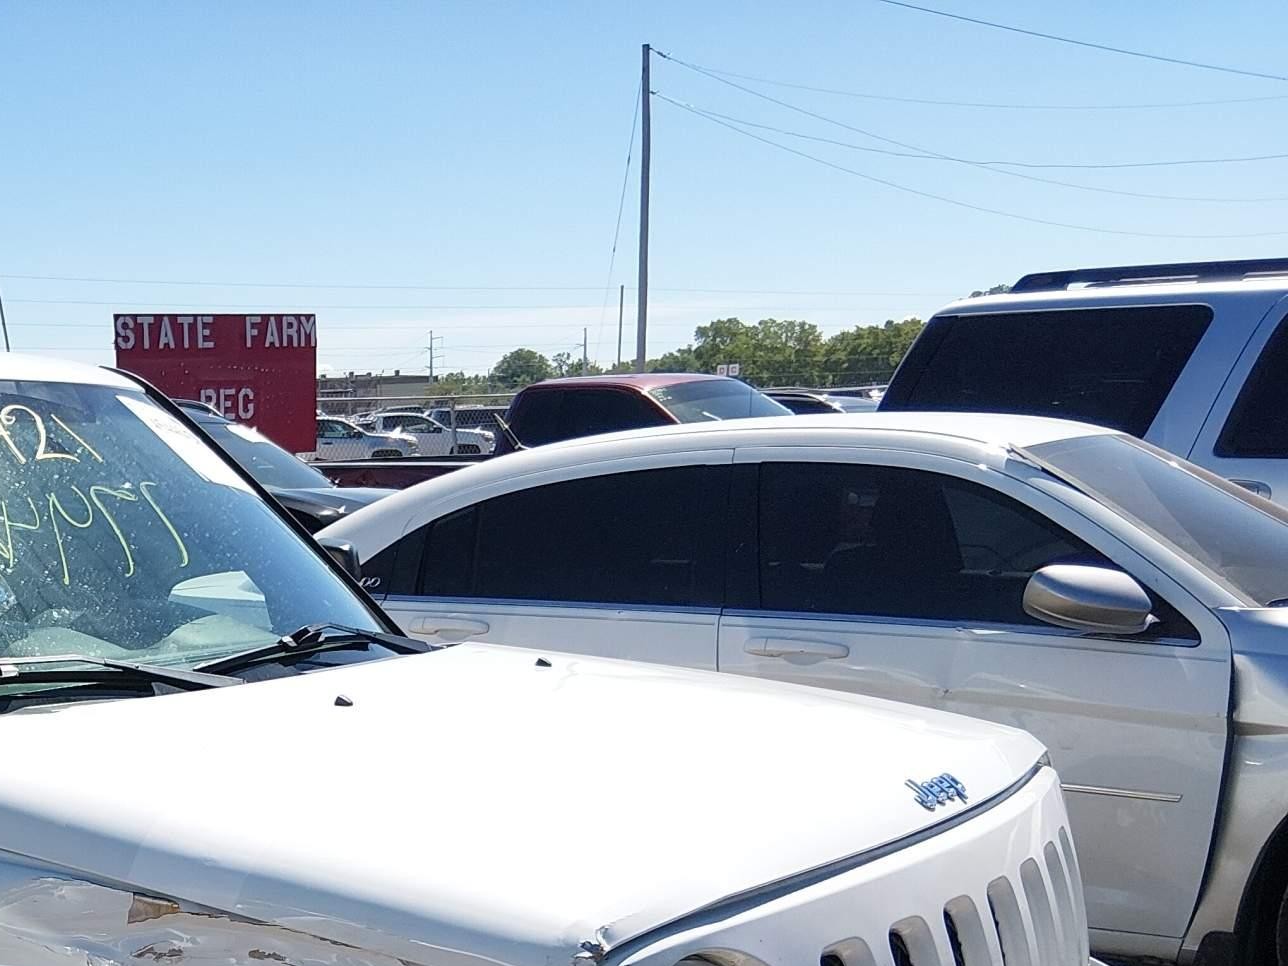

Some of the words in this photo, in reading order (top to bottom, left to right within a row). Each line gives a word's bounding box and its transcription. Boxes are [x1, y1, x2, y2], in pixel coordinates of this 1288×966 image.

[115, 315, 215, 350] STATE
[244, 315, 317, 348] FARM
[903, 771, 969, 813] Jeep
